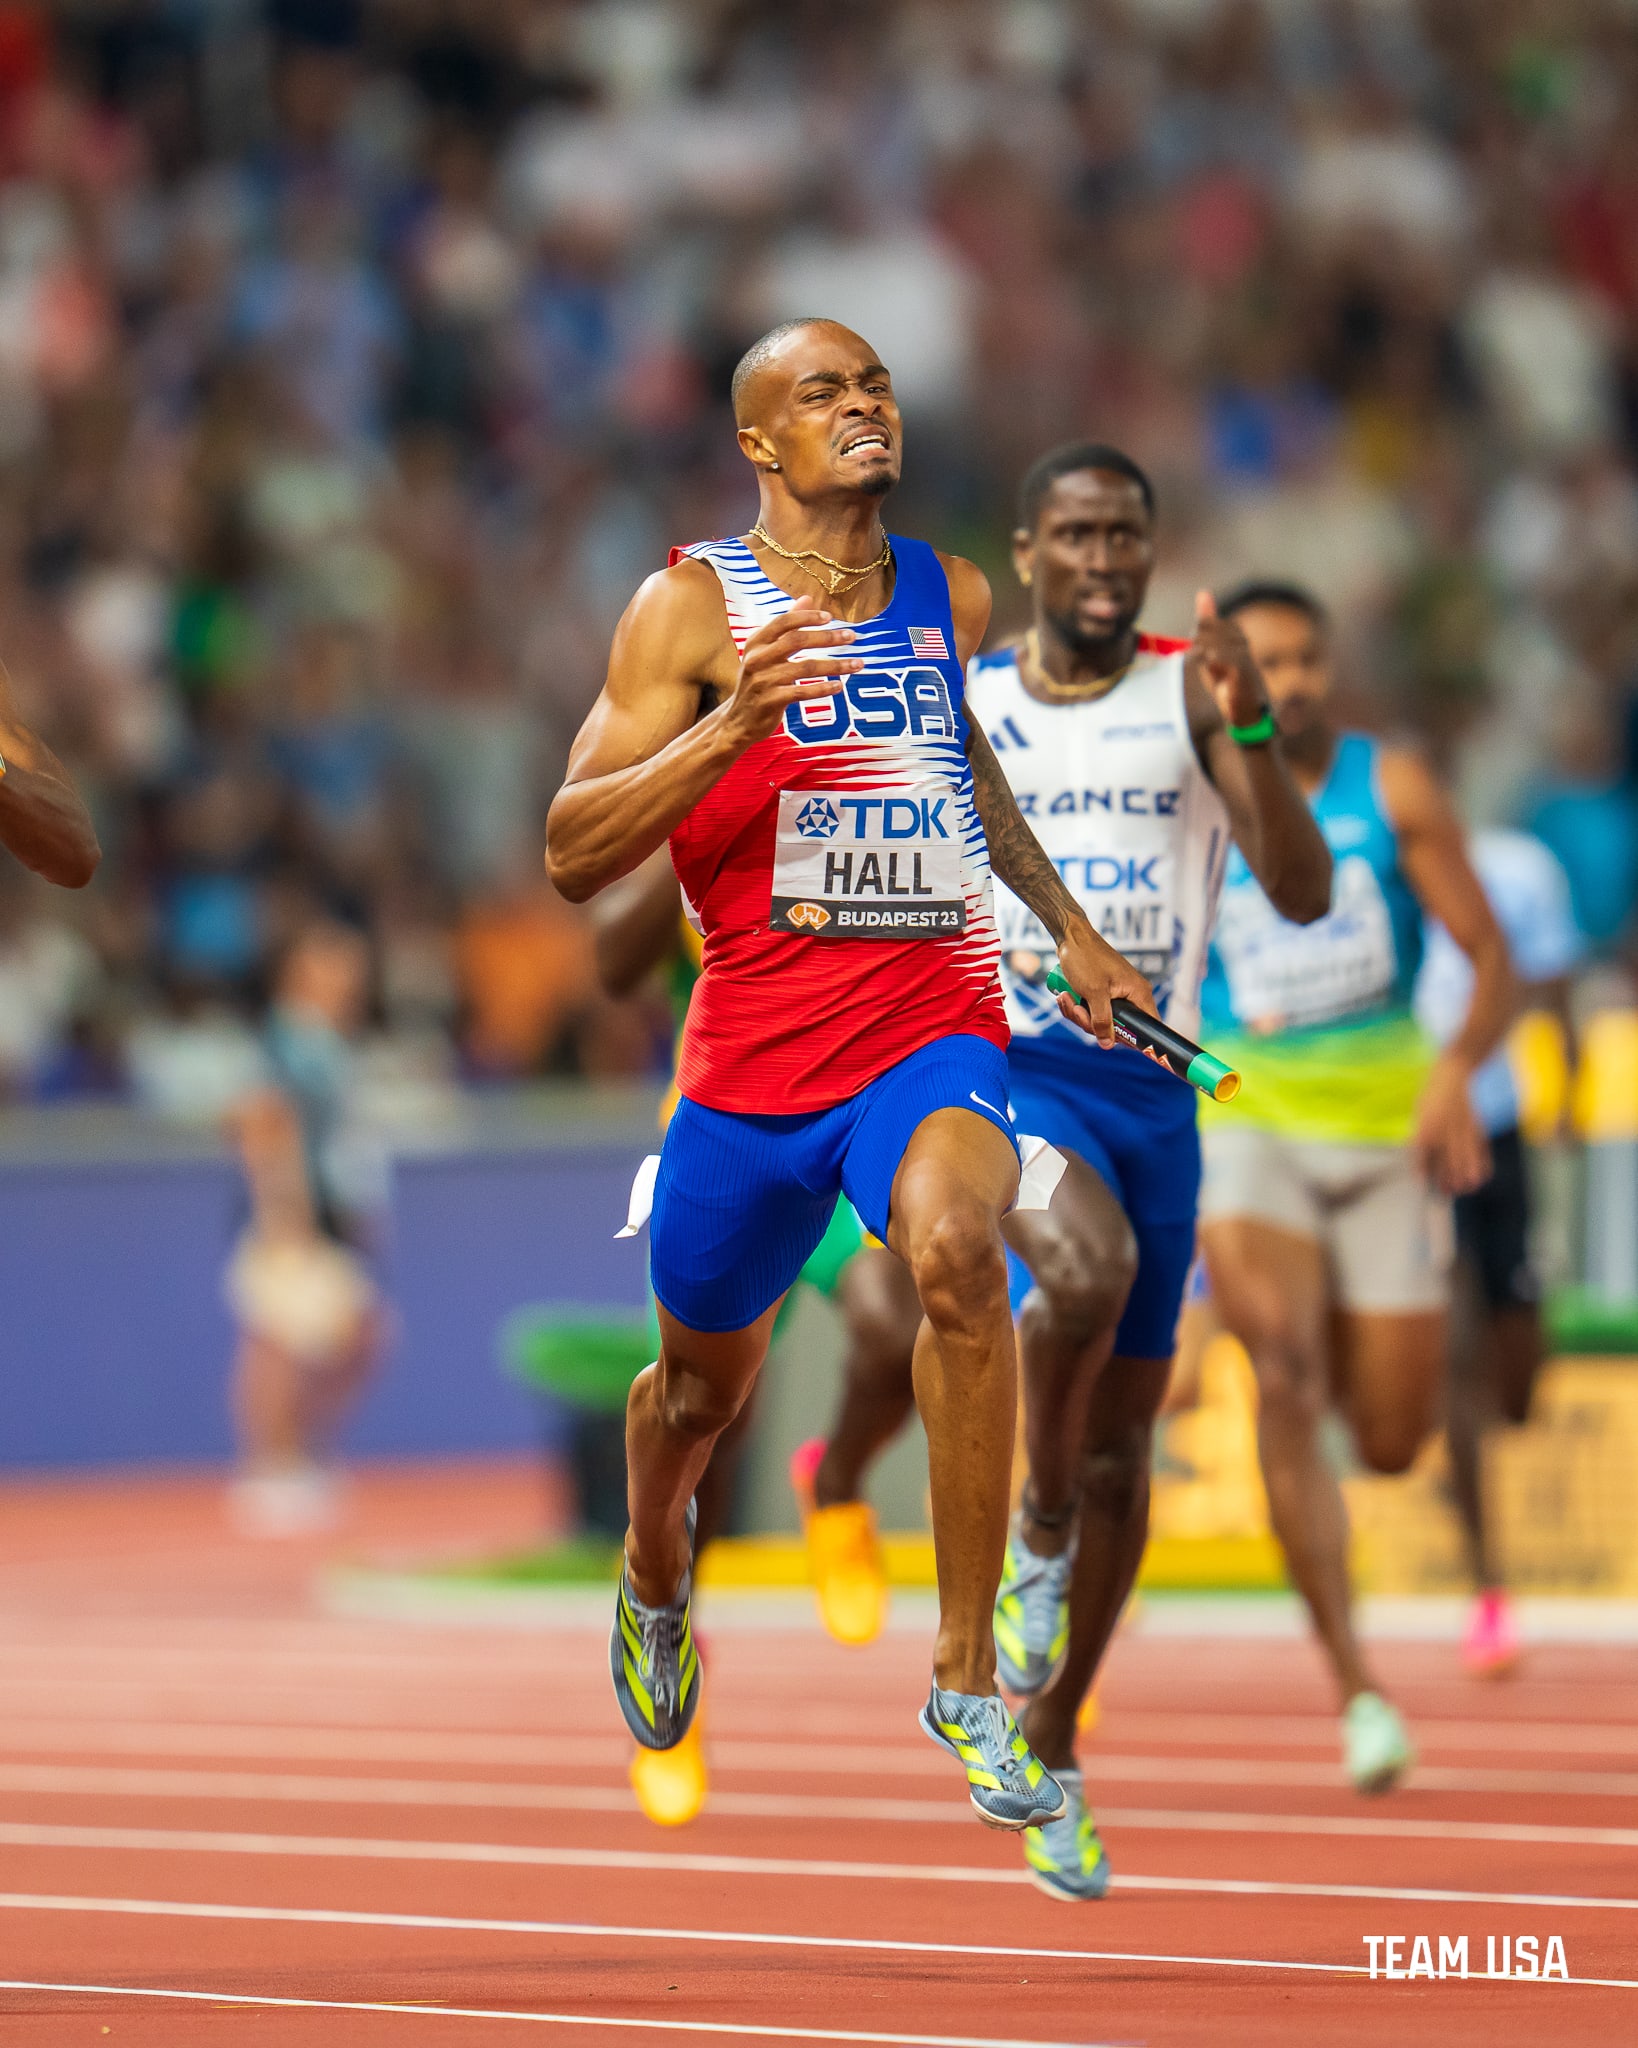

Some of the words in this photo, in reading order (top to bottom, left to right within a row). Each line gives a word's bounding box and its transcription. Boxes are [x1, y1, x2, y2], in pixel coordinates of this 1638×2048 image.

[784, 667, 956, 745] USA
[840, 798, 950, 839] TDK
[1014, 788, 1180, 818] RANCE
[824, 852, 933, 895] HALL
[1051, 857, 1159, 891] TDK
[1001, 905, 1163, 942] VAANT
